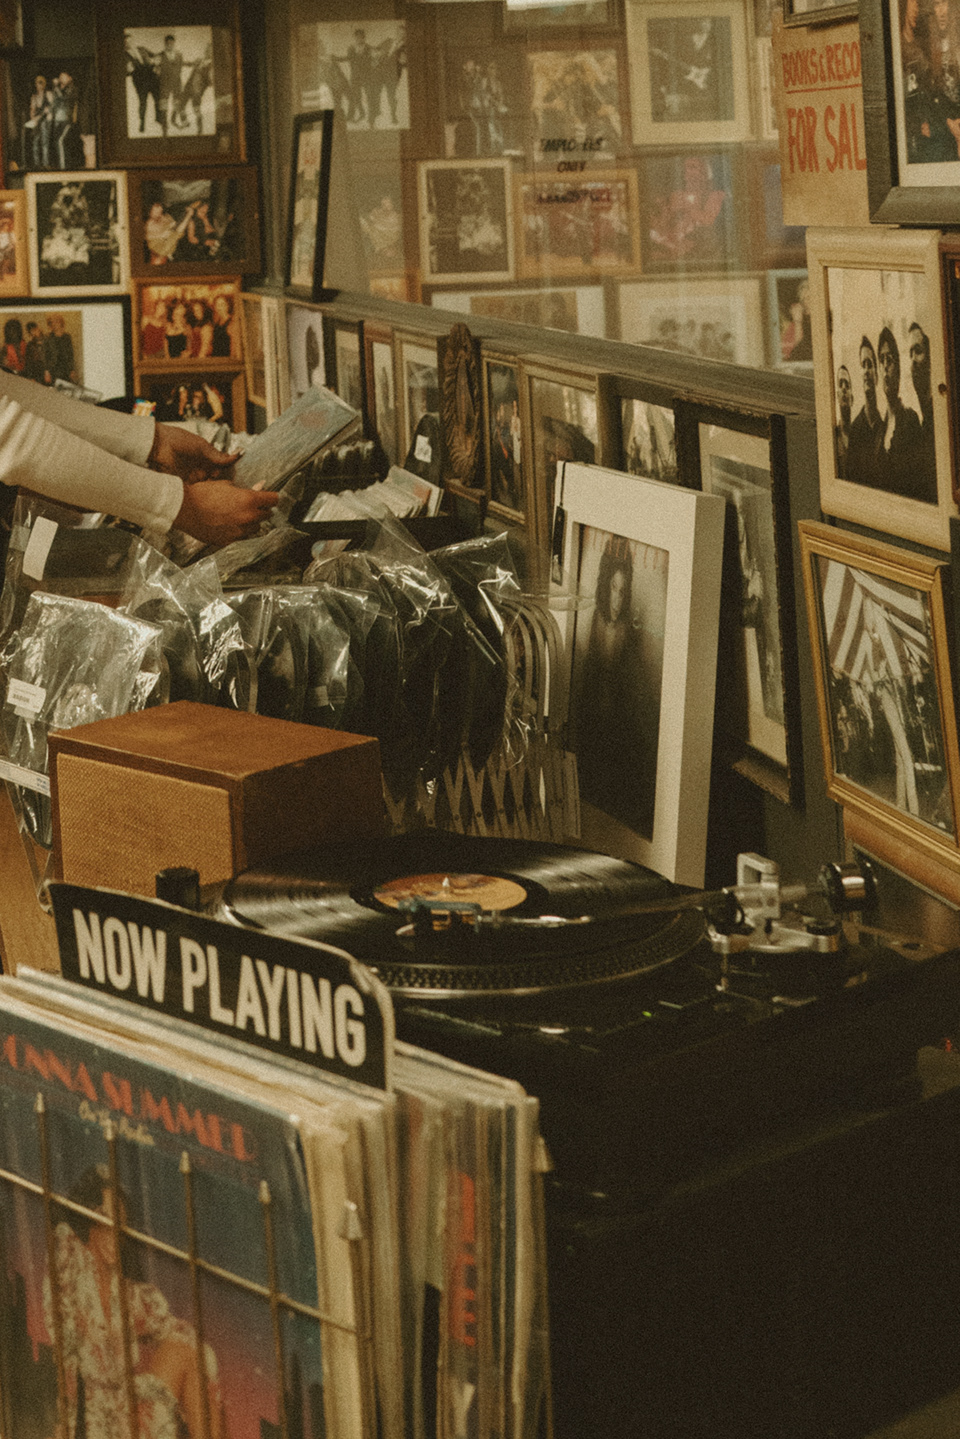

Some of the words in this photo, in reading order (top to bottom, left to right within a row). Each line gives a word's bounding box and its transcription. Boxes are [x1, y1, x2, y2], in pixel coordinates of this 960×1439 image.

[782, 48, 818, 87] BOOKS
[787, 106, 820, 173] FOR
[824, 103, 868, 173] SAL
[72, 908, 167, 1004] NOW
[179, 936, 367, 1067] PLAYING
